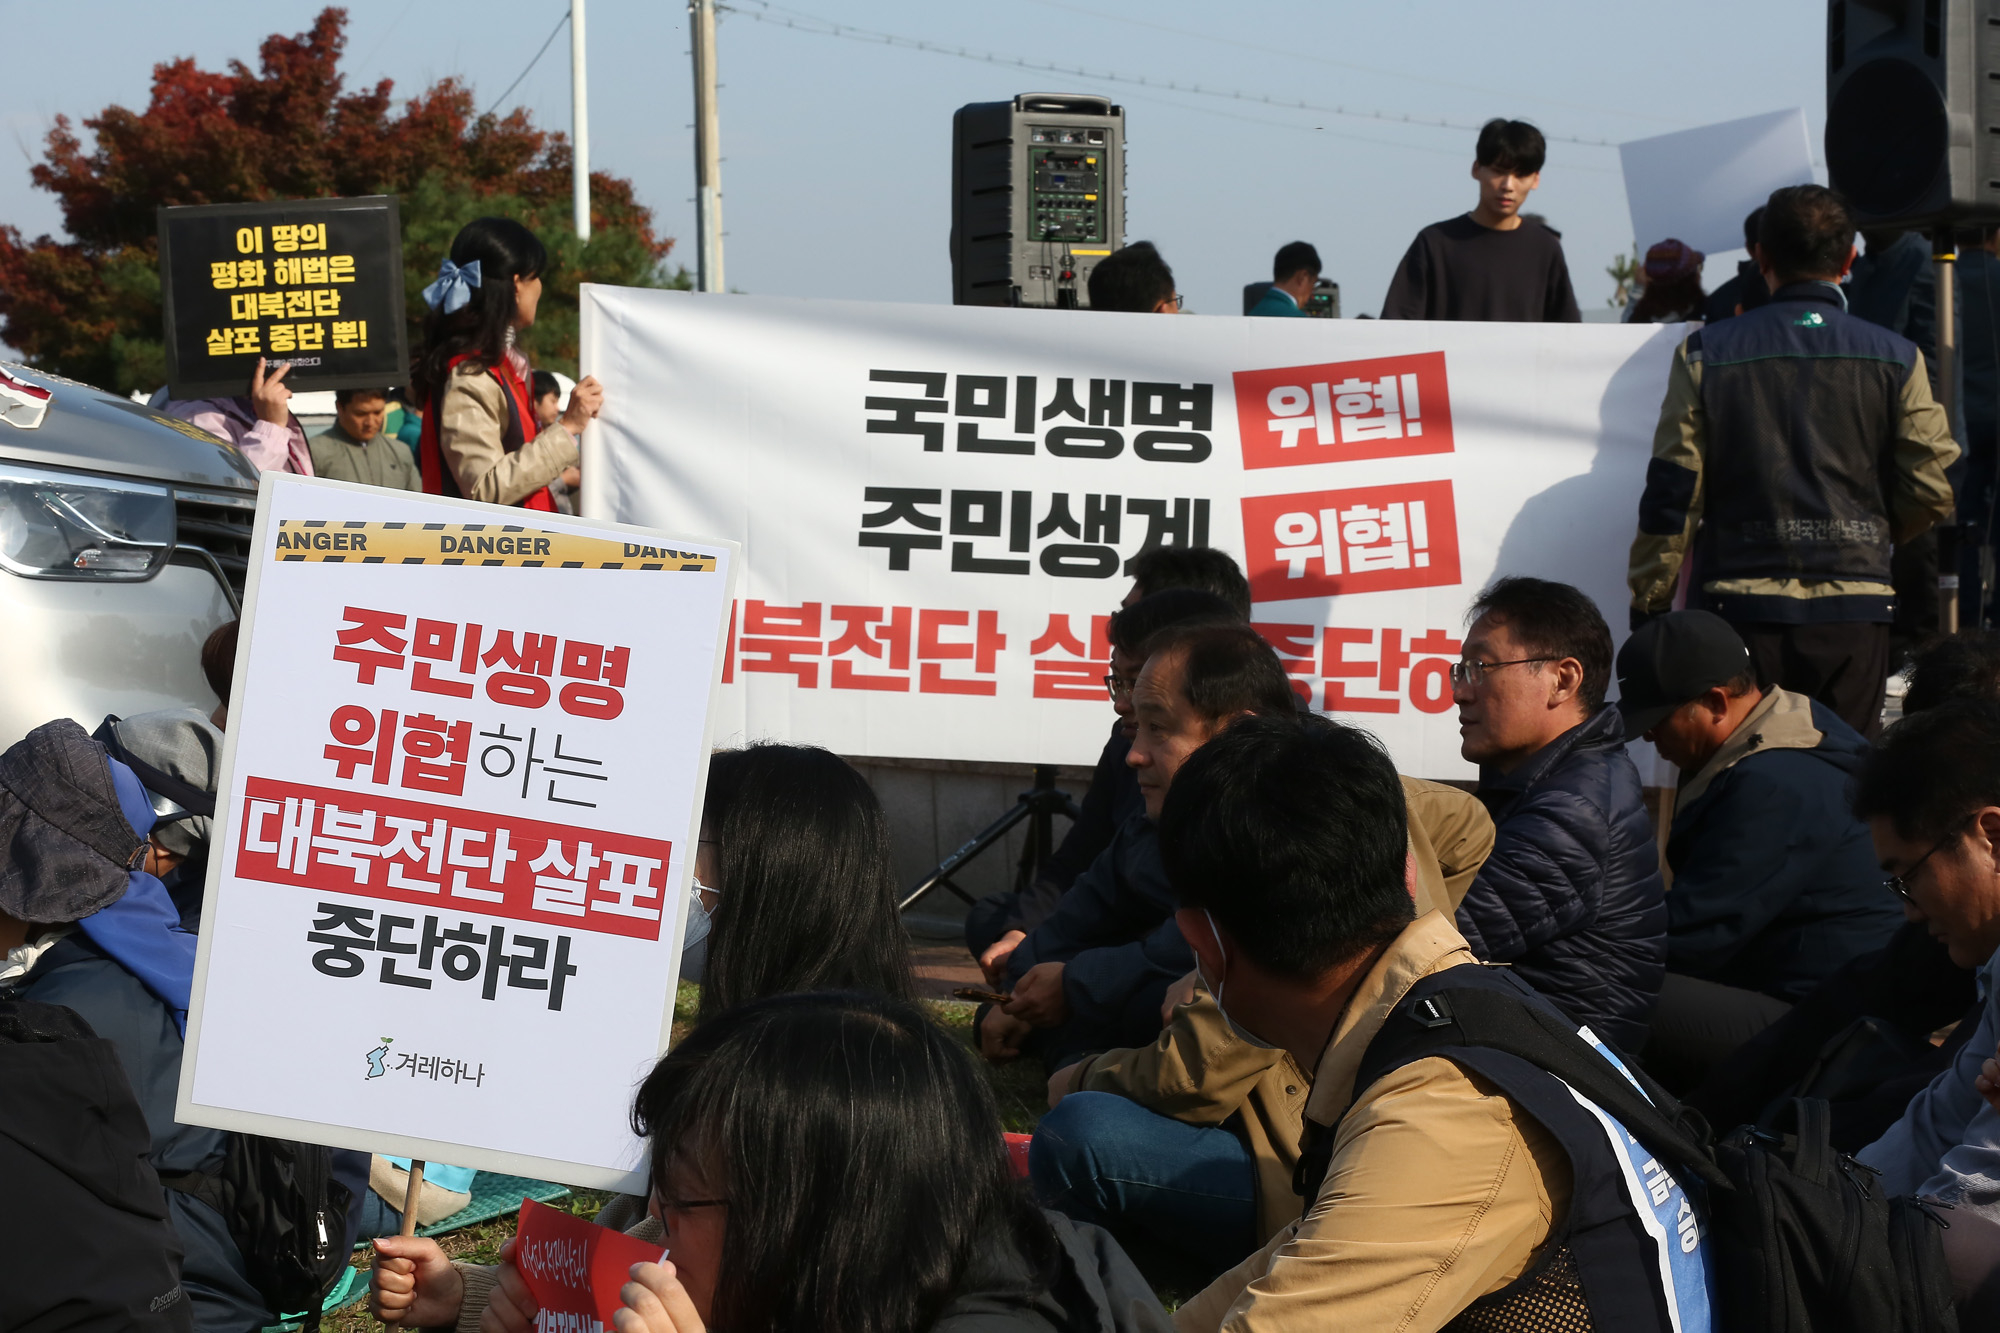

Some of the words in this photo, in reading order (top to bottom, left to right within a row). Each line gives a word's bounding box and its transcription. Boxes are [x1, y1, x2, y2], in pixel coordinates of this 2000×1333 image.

[211, 260, 267, 289] 평화
[274, 255, 355, 285] 해법은
[236, 227, 263, 253] 이
[271, 223, 327, 253] 땅의
[206, 327, 261, 356] 살포
[269, 322, 325, 352] 중단
[332, 321, 368, 349] 뿐!
[231, 289, 341, 320] 대북전단
[865, 369, 1213, 463] 국민생명
[1267, 373, 1424, 448] 위협!
[440, 536, 550, 555] DANGER
[624, 543, 715, 559] DAN
[859, 486, 1210, 579] 주민생계
[1273, 500, 1430, 578] 위협!
[333, 606, 630, 721] 주민생명
[721, 598, 1006, 696] 북전단
[323, 704, 608, 808] 위협하는
[245, 797, 517, 903] 대북전단
[528, 840, 661, 921] 살포
[307, 902, 577, 1011] 중단하라
[395, 1053, 485, 1087] 겨레하나
